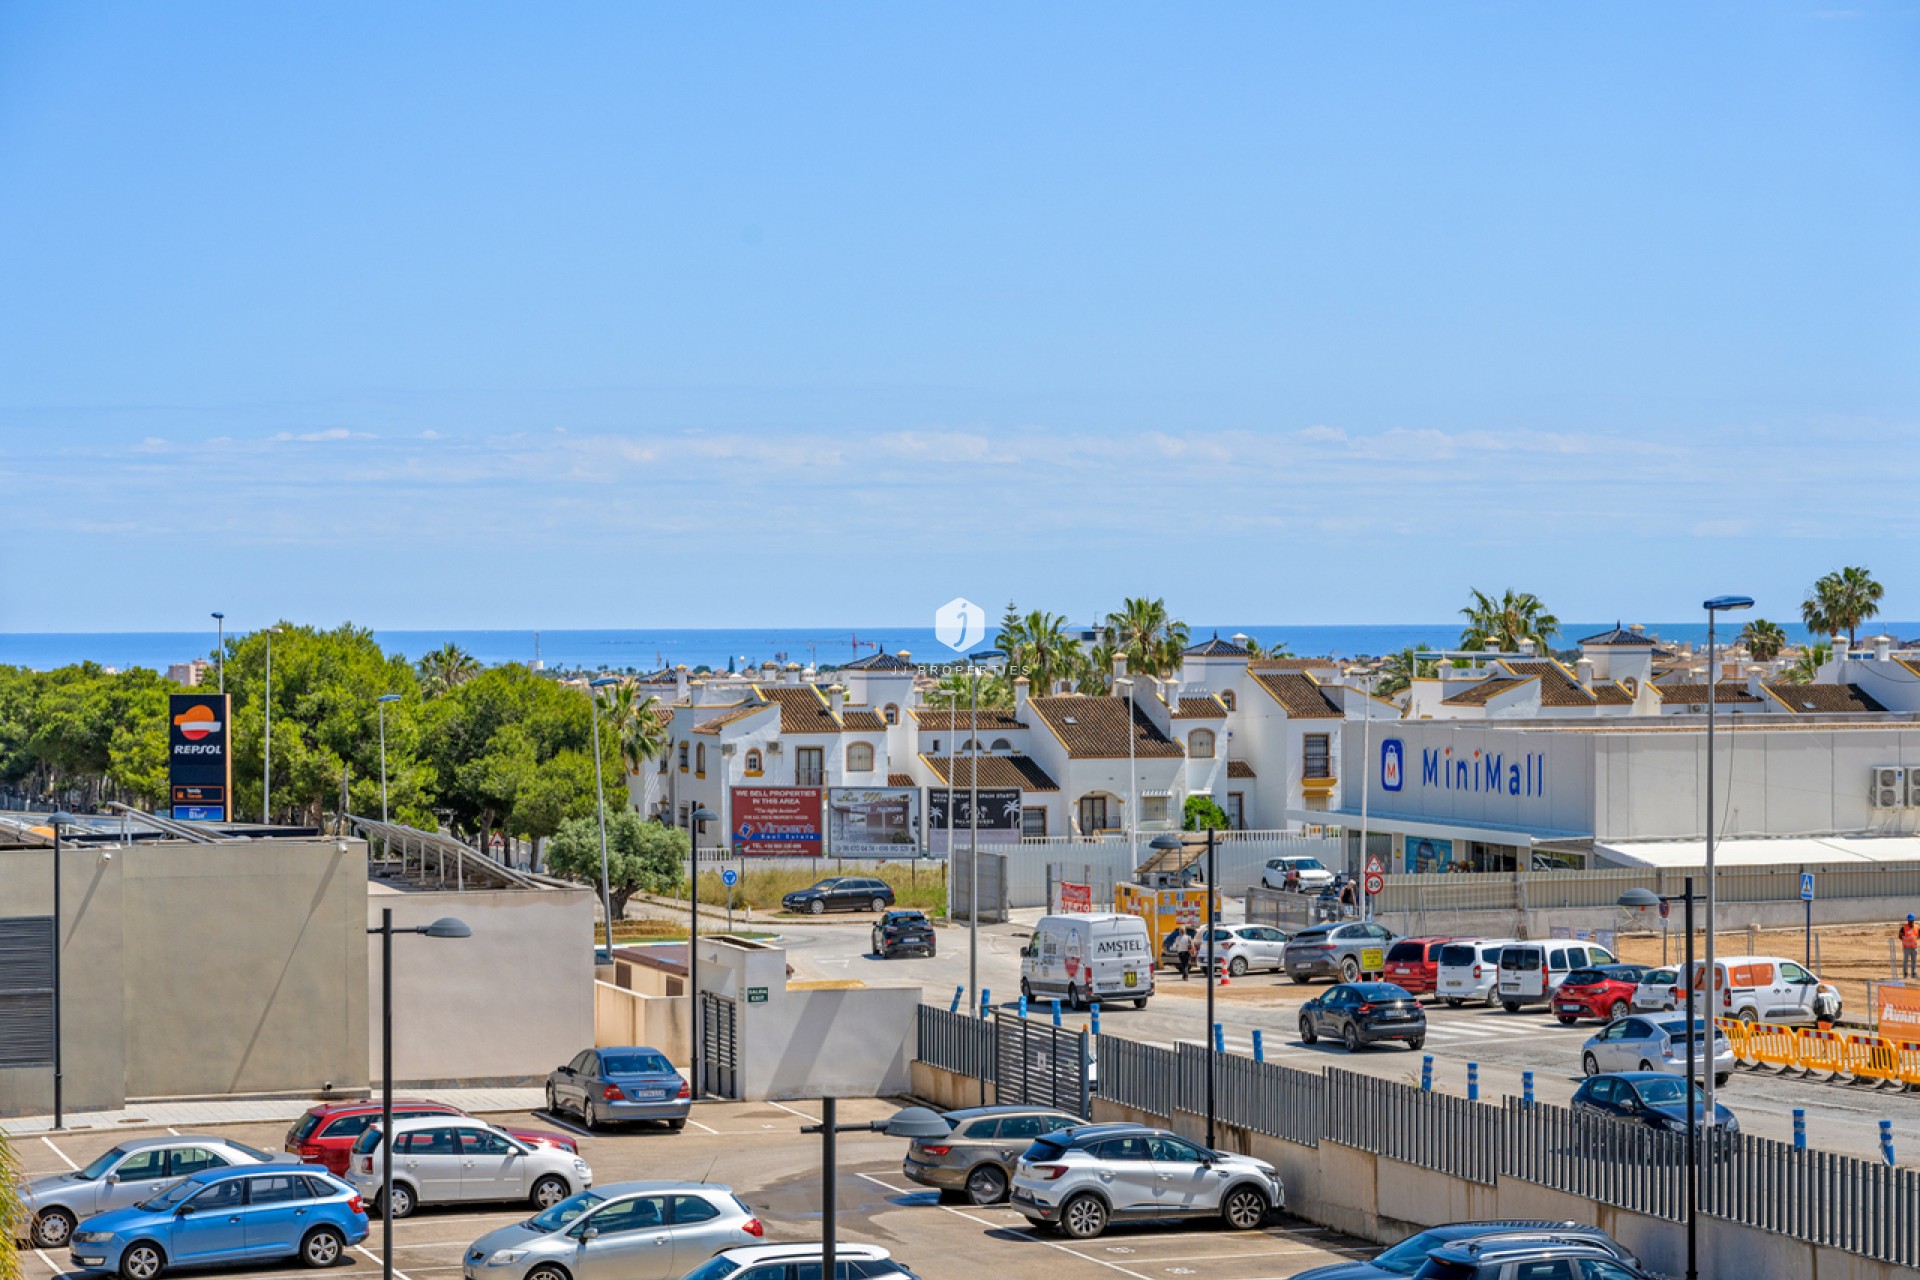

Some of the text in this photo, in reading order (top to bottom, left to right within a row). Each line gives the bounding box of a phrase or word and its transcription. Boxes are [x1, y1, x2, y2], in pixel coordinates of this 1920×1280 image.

[174, 744, 222, 754] REPSOL
[1422, 746, 1544, 798] MiniMall
[756, 822, 816, 834] Vincent
[1368, 880, 1380, 889] 30
[1097, 940, 1143, 953] AMSTEL
